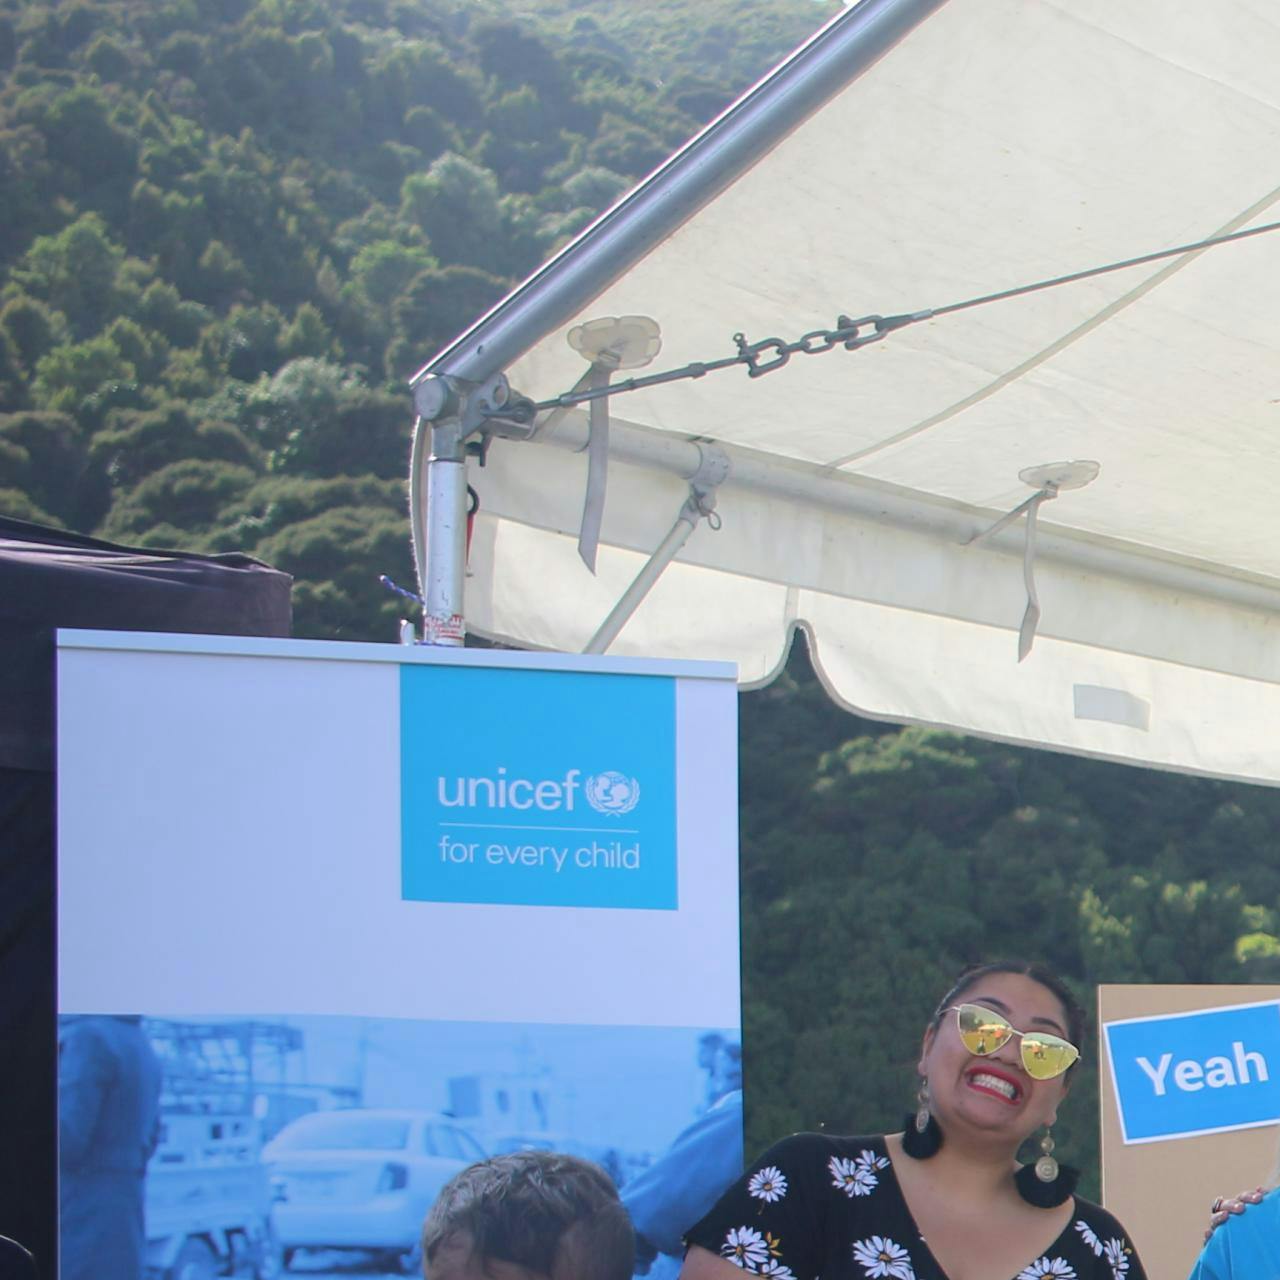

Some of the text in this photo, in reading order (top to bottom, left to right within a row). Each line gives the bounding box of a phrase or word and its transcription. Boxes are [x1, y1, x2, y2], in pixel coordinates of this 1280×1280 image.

[437, 767, 581, 811] unicef
[439, 835, 640, 873] for every child
[1135, 1040, 1270, 1097] Yeah
